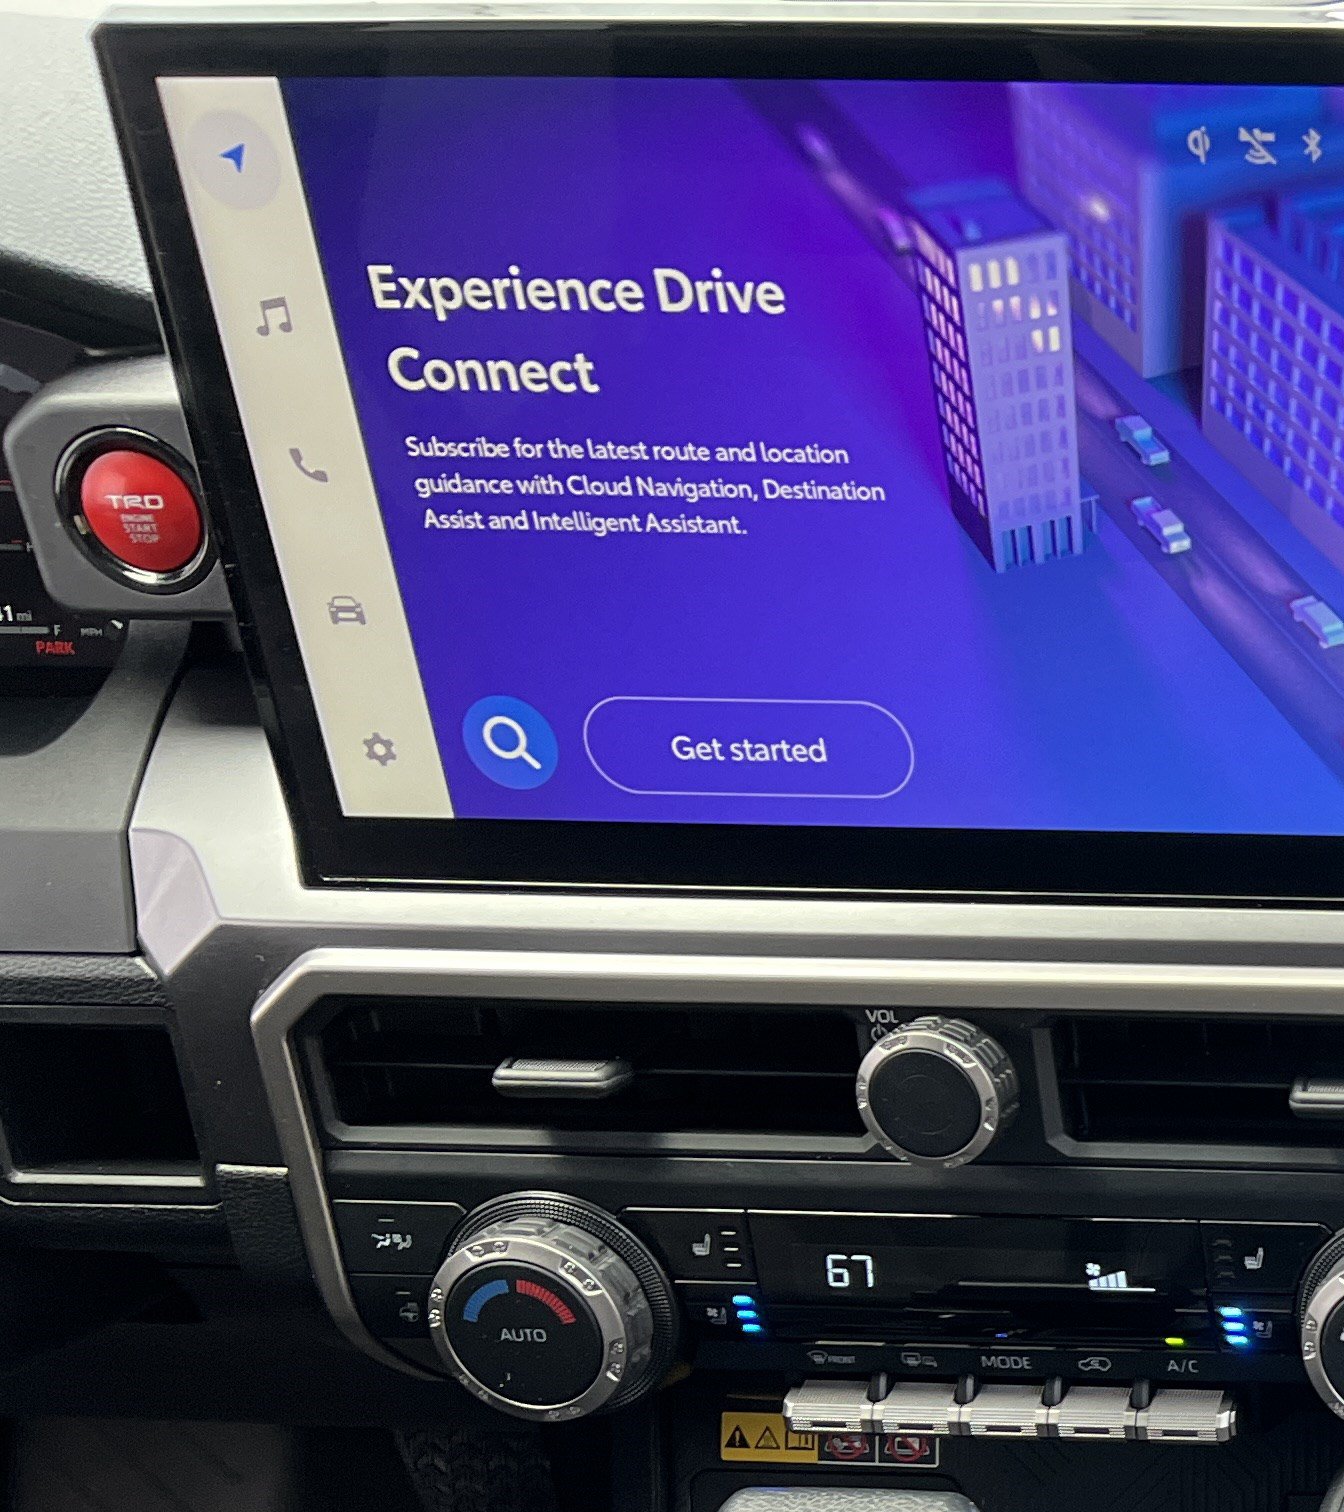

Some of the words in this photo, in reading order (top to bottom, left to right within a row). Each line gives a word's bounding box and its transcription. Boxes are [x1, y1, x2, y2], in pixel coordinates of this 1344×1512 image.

[366, 264, 645, 322] Experience
[652, 267, 787, 315] Drive
[387, 346, 600, 393] Connect
[404, 435, 510, 459] Subscribe
[513, 437, 544, 459] for
[547, 437, 584, 459] the
[586, 438, 650, 461] latest
[652, 442, 711, 462] route
[714, 441, 757, 463] and
[759, 441, 849, 464] location
[414, 472, 514, 499] guidance
[516, 474, 565, 495] with
[566, 474, 633, 497] Cloud
[635, 476, 759, 503] Navigation,
[761, 478, 887, 502] Destination
[104, 494, 164, 510] TRD
[122, 523, 157, 534] START
[423, 507, 486, 530] Assist
[488, 509, 530, 531] and
[531, 510, 644, 537] Intelligent
[645, 512, 749, 536] Assistant.
[129, 533, 160, 544] STOP
[53, 624, 61, 637] F
[36, 640, 76, 656] PARK
[670, 735, 726, 761] Get
[729, 737, 828, 763] started
[865, 1009, 900, 1024] VOL
[825, 1253, 875, 1289] 67
[499, 1327, 548, 1343] AUTO
[980, 1355, 1033, 1370] MODE
[1167, 1359, 1200, 1373] A/C
